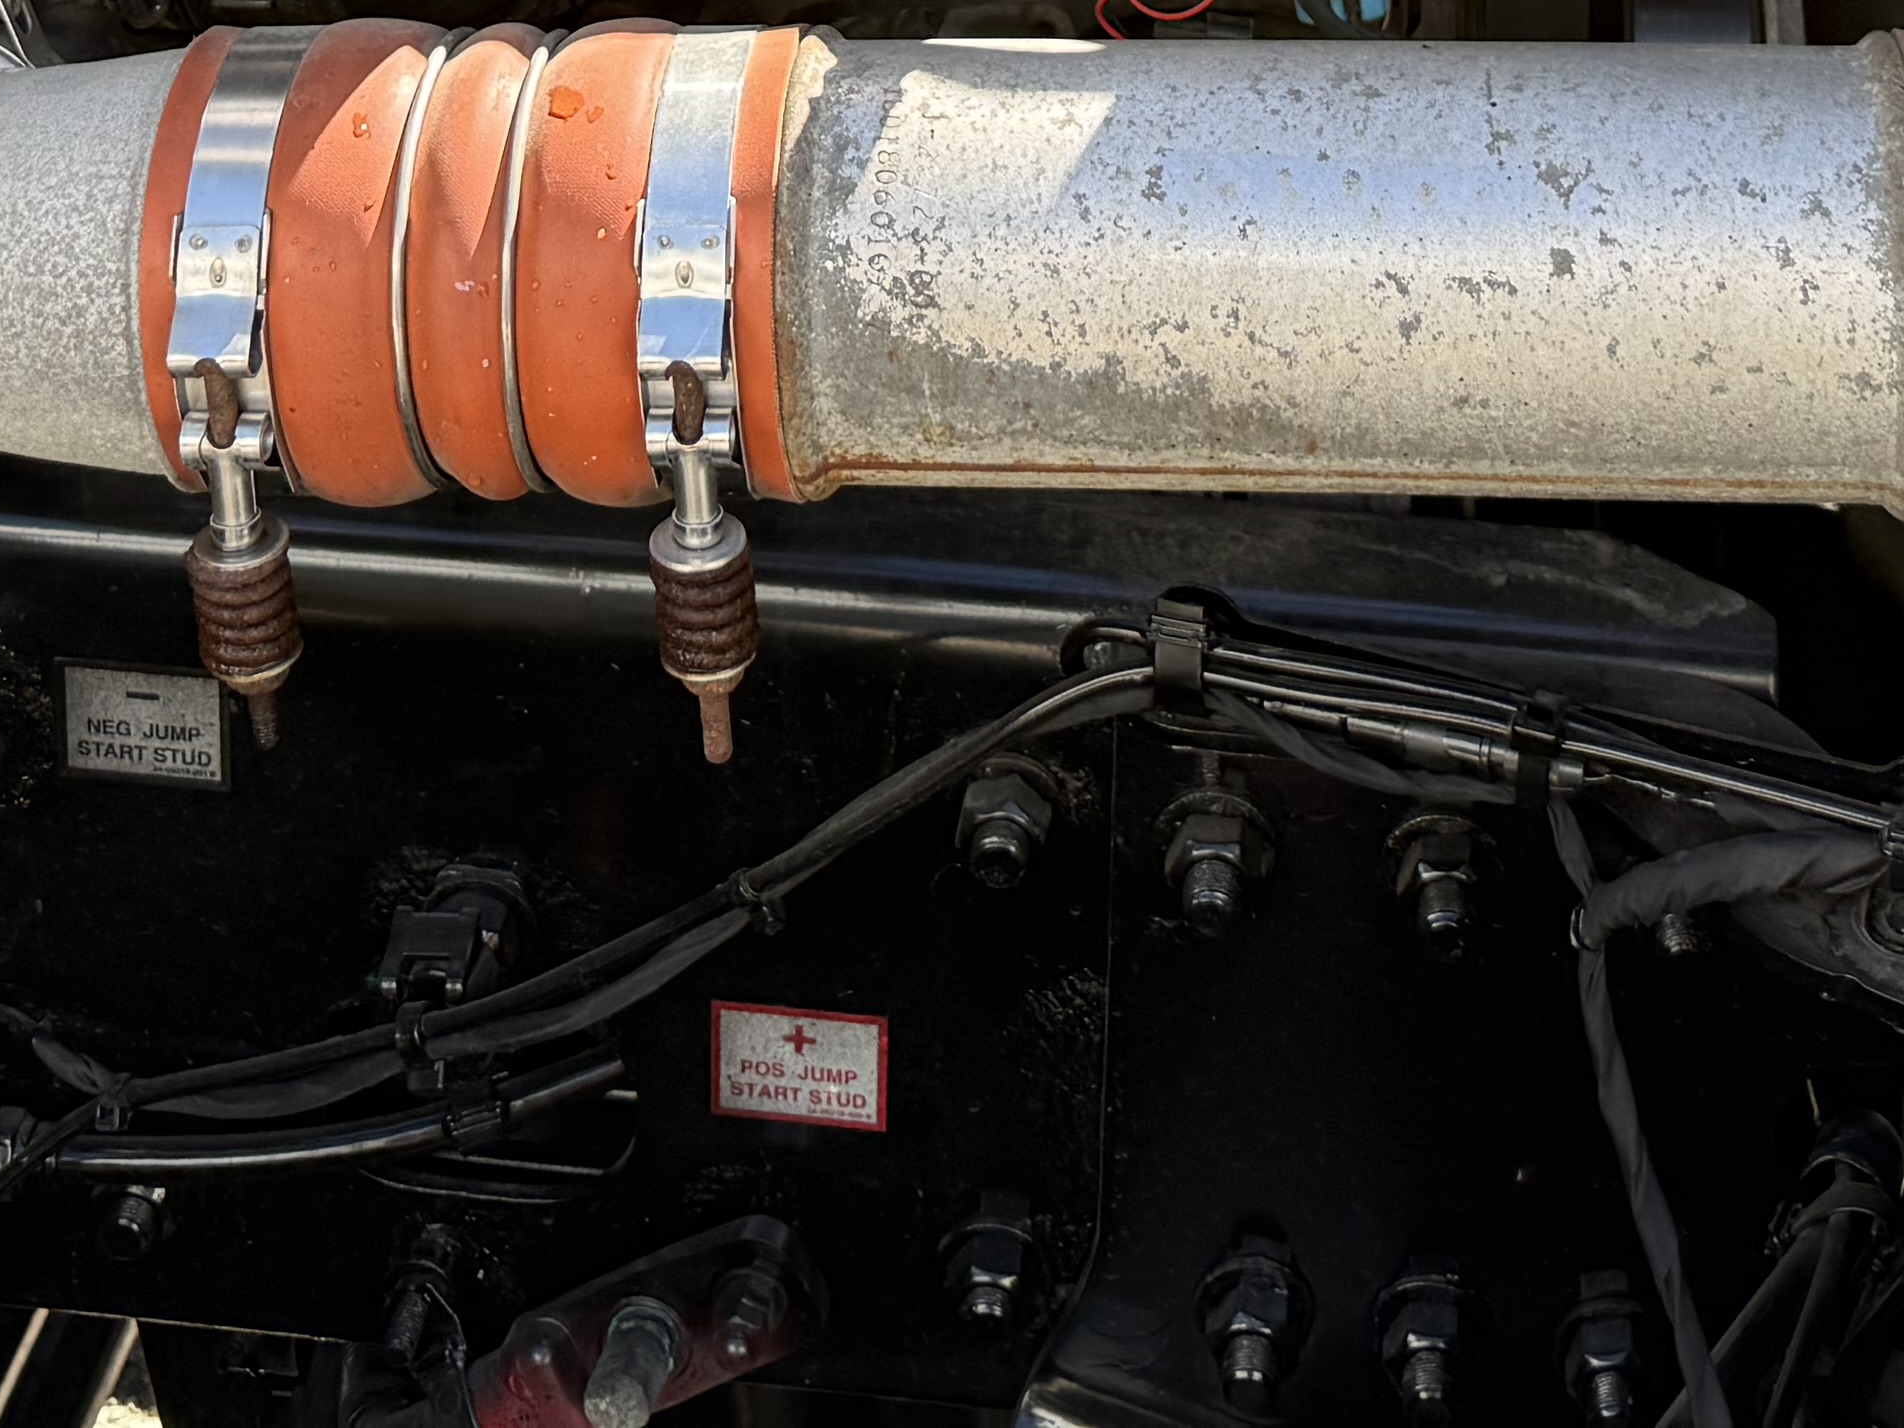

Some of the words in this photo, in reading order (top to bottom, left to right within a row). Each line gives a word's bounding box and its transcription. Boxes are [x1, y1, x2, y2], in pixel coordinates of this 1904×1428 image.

[86, 717, 132, 737] NEG
[142, 722, 202, 743] JUMP
[77, 740, 148, 762] START
[153, 746, 212, 768] STUD
[740, 1058, 786, 1079] POS
[797, 1064, 858, 1085] JUMP
[729, 1080, 802, 1103] START
[808, 1088, 867, 1110] STUD
